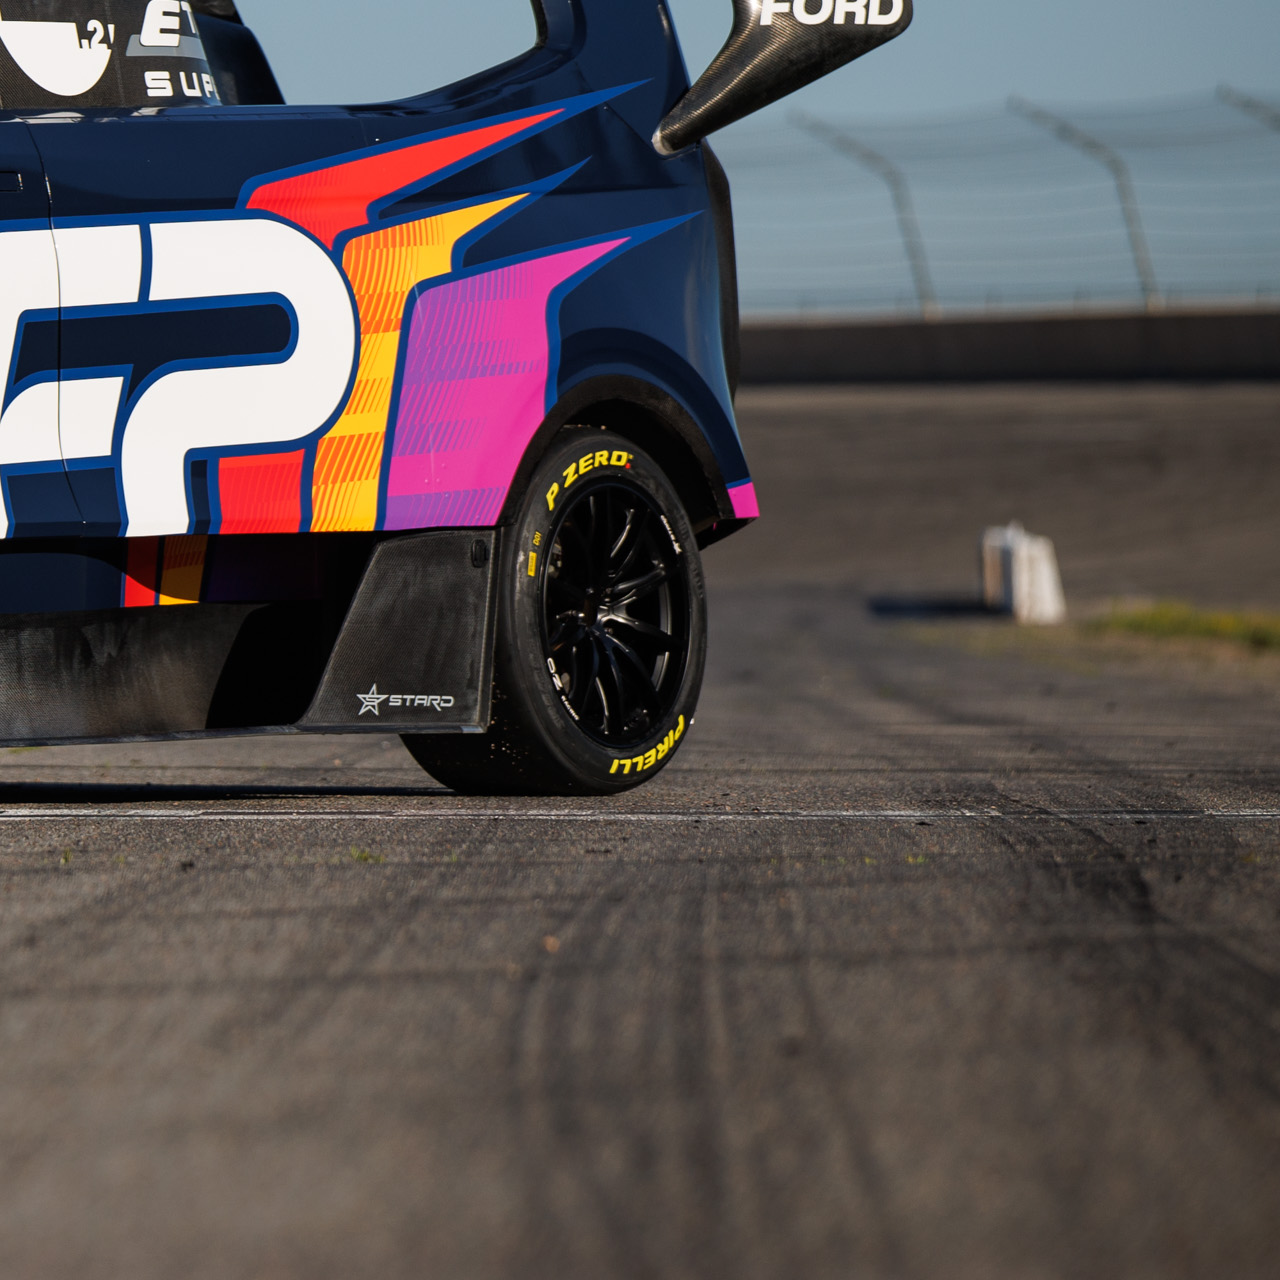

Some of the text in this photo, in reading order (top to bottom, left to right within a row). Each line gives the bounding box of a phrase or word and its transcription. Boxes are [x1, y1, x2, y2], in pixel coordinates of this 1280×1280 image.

[144, 71, 221, 100] SUP
[545, 449, 629, 511] P ZERO
[388, 694, 455, 711] STARD
[609, 714, 685, 775] PIRELLI
